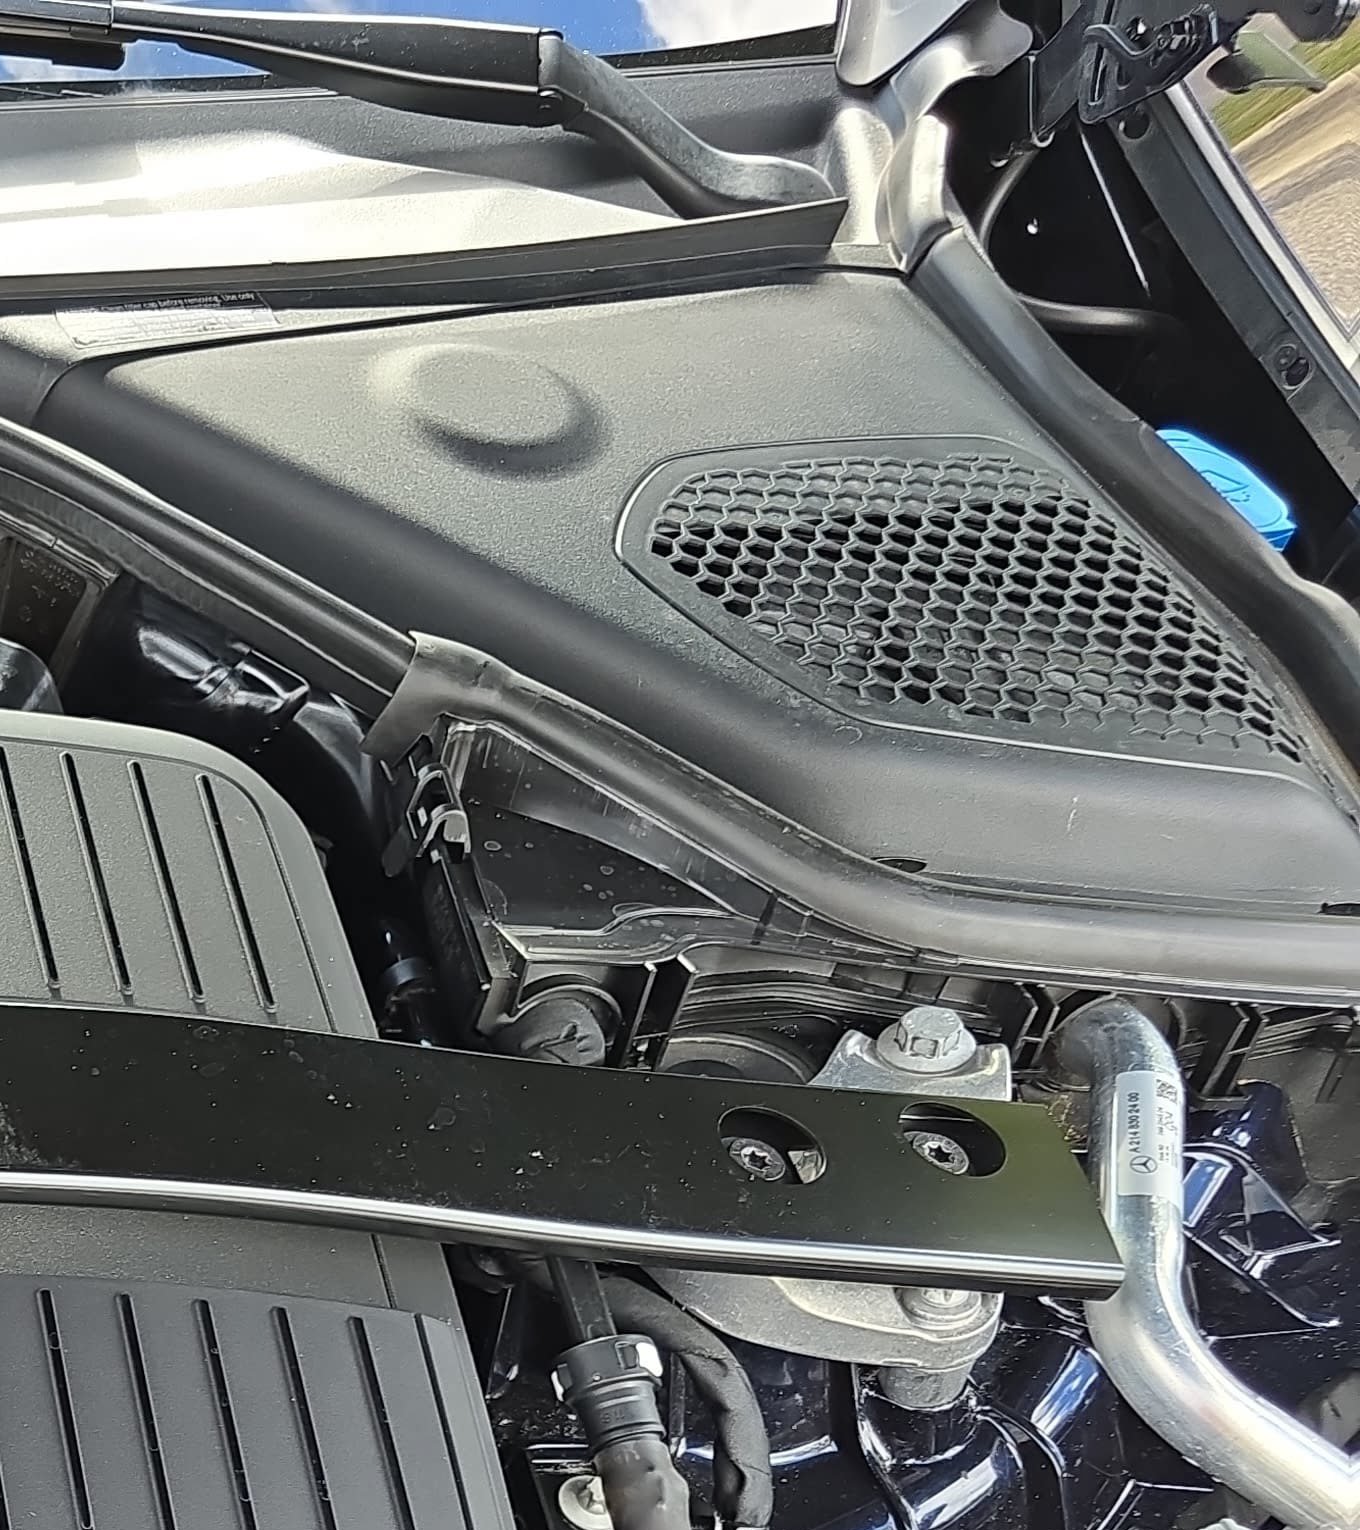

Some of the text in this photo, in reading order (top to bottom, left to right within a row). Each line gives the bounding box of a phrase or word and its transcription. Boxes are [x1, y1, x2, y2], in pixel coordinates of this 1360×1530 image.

[1128, 1092, 1140, 1102] 00
[1128, 1103, 1140, 1114] 24
[1128, 1131, 1140, 1146] 214
